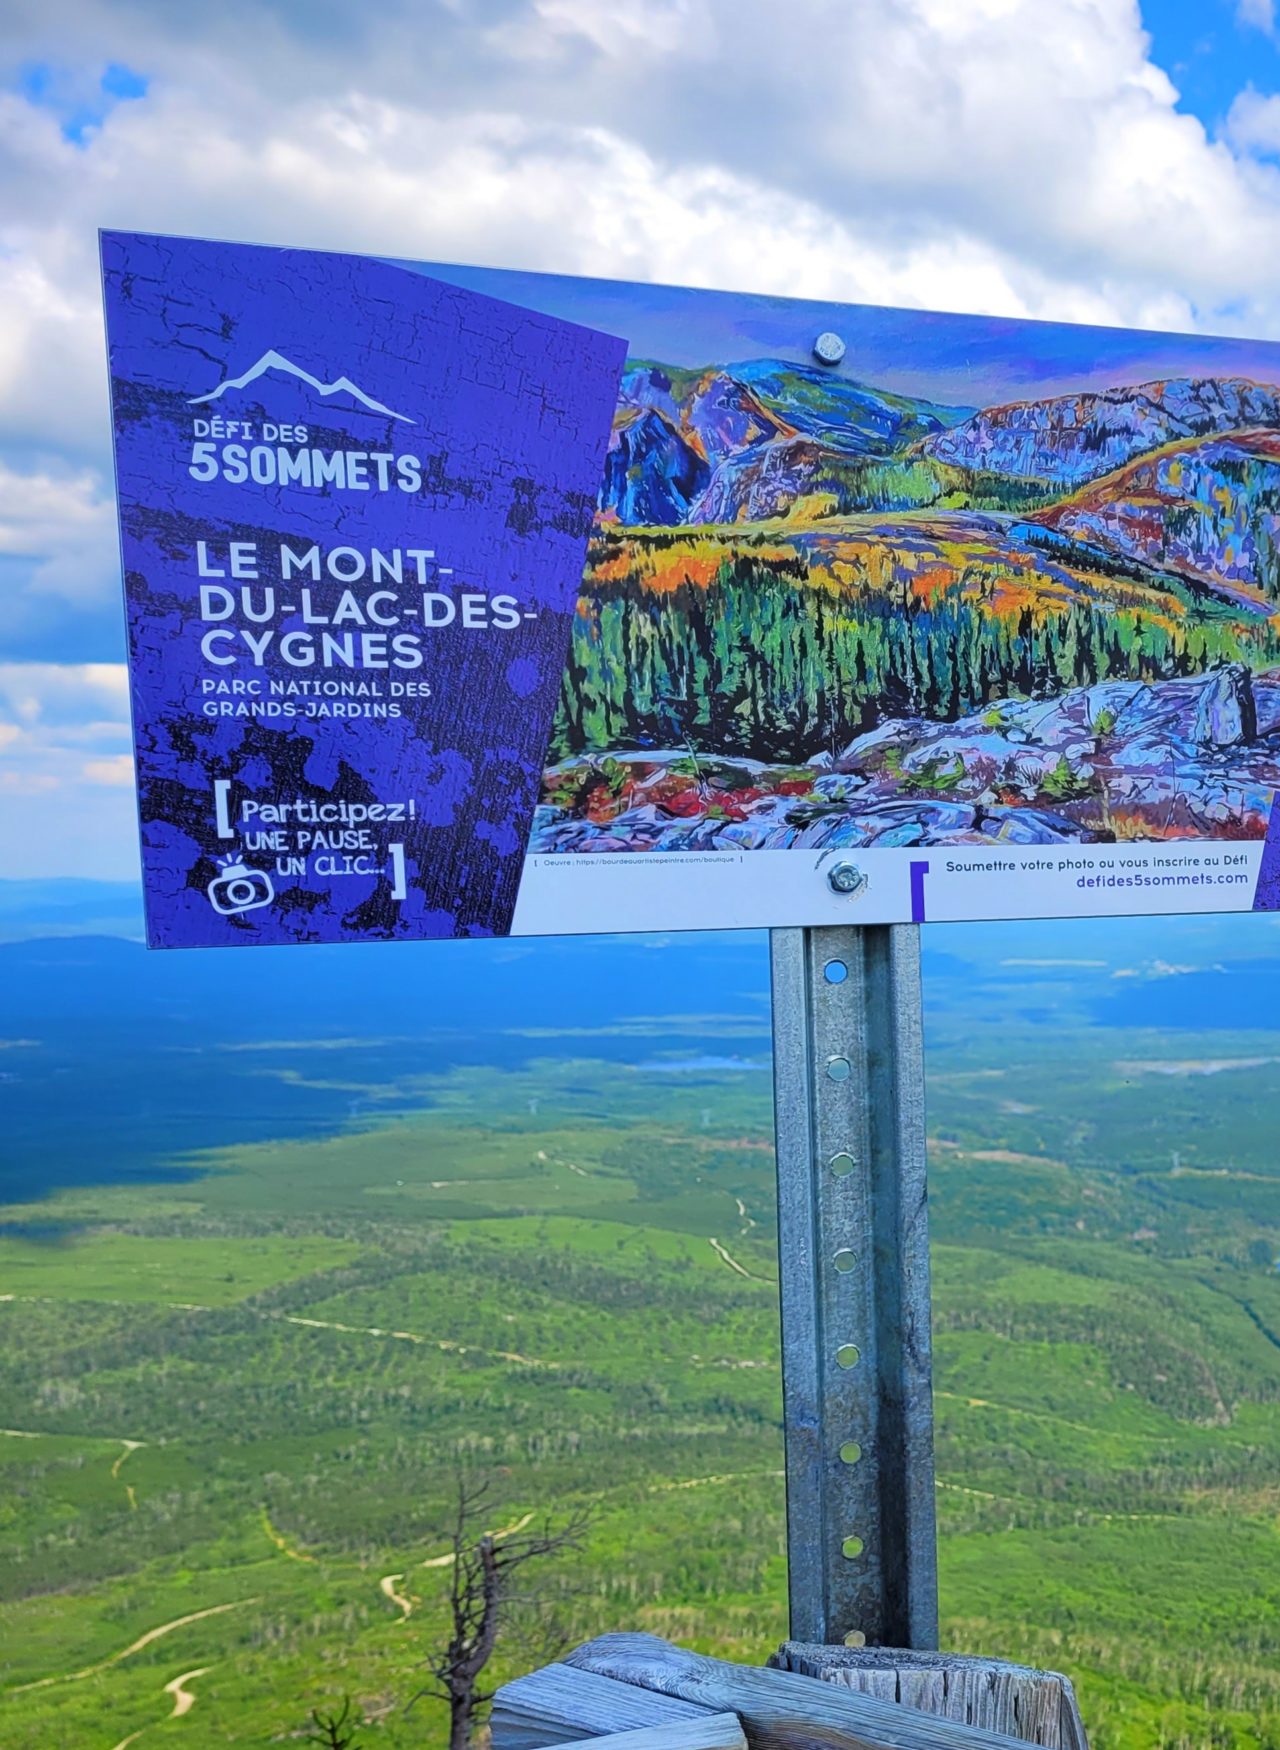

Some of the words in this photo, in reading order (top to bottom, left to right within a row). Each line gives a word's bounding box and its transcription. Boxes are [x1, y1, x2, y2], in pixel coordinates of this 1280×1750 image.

[263, 424, 308, 443] DES
[188, 442, 422, 493] 5SOMMETS
[197, 541, 259, 579] LE
[280, 544, 453, 584] MONT-
[200, 585, 538, 629] DU-LAC-DES-
[201, 630, 423, 669] CYGNES
[202, 680, 262, 695] PARC
[270, 681, 383, 697] NATIONAL
[390, 682, 431, 697] DES
[202, 701, 402, 718] GRANDS-JARDINS
[242, 800, 416, 828] Participez!
[245, 831, 289, 850] UNE
[297, 831, 378, 851] PAUSE,
[276, 858, 306, 876] UN
[315, 857, 385, 875] CLIC...
[946, 861, 1016, 872] Soumettre
[1020, 860, 1053, 870] votre
[1058, 859, 1095, 872] photo
[1099, 860, 1114, 868] ou
[1119, 859, 1149, 868] vous
[1153, 857, 1200, 867] inscrire
[1204, 857, 1219, 865] au
[1224, 855, 1248, 865] Défi
[1076, 873, 1248, 888] defides5sommets.com
